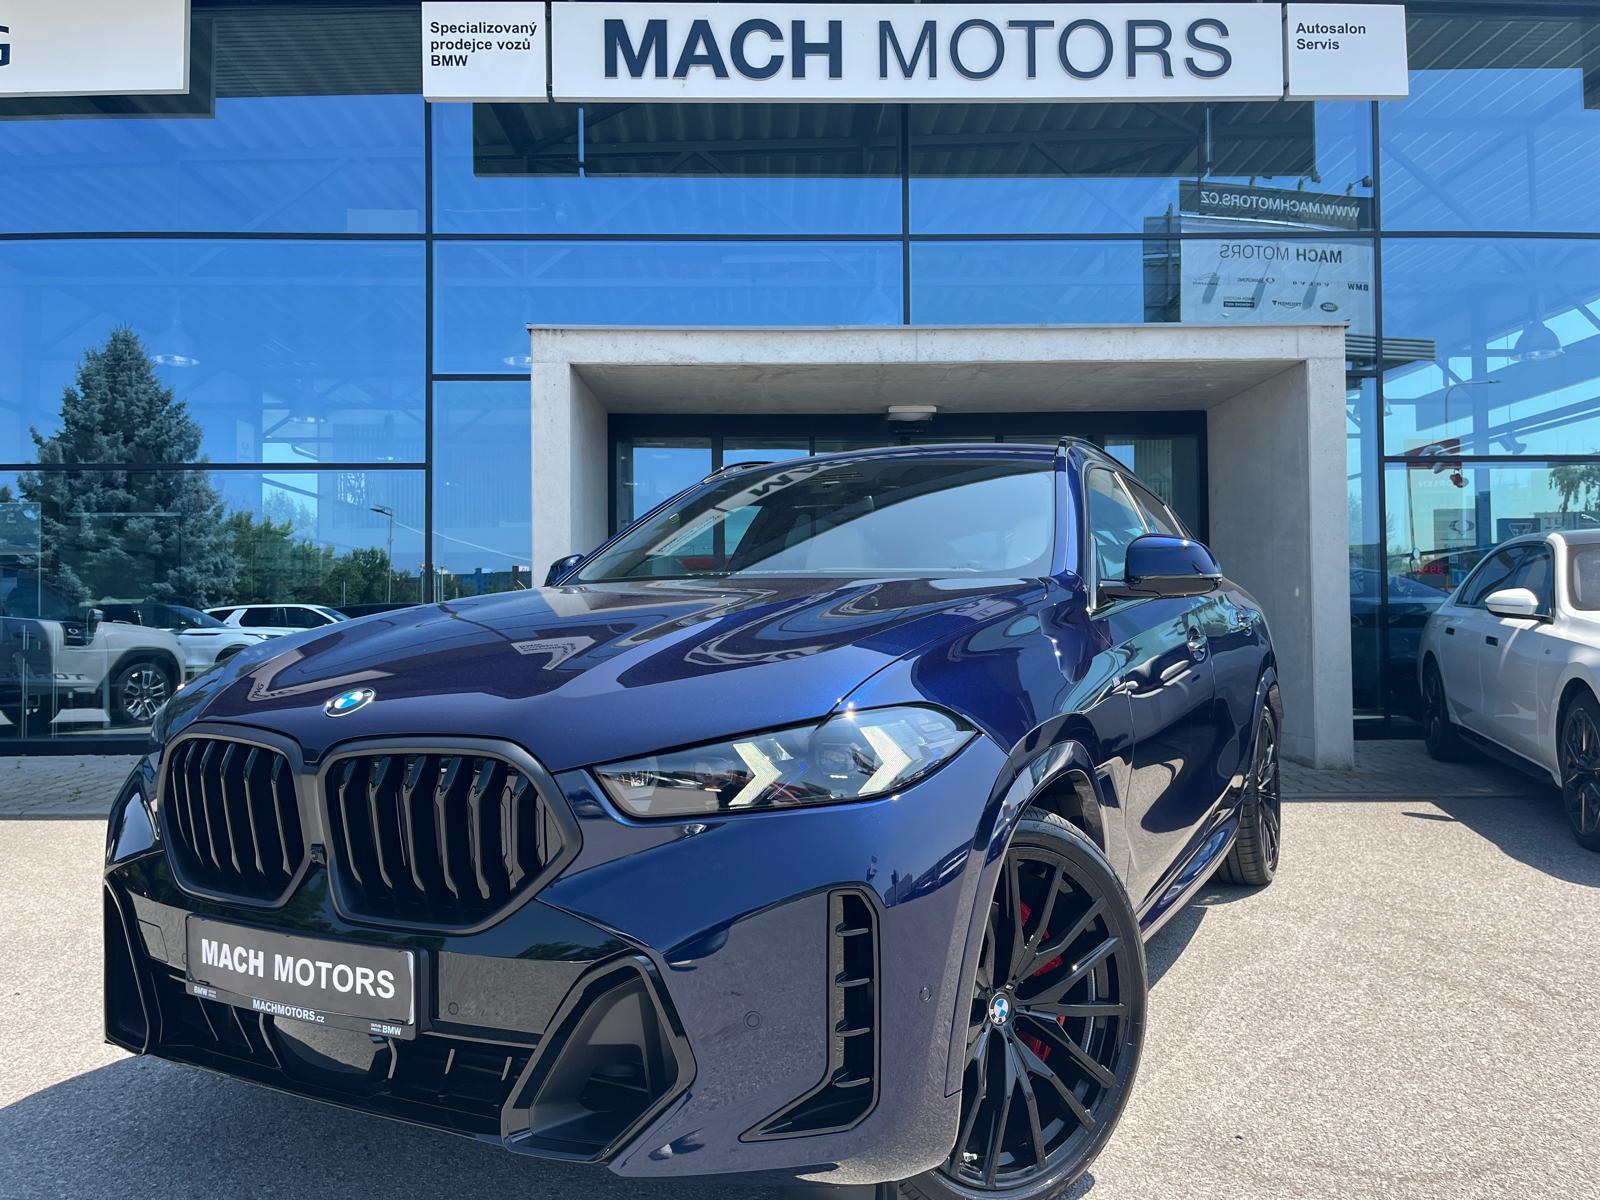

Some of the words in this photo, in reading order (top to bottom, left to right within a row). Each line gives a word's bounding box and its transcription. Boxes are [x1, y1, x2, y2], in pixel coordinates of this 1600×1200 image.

[430, 21, 537, 36] Specializovaný
[1296, 22, 1366, 34] Autosalon
[430, 38, 493, 53] prodejce
[497, 38, 531, 50] vozů
[604, 19, 843, 80] MACH
[878, 18, 1233, 80] MOTORS
[1296, 38, 1340, 50] Servis
[431, 54, 468, 66] BMW
[201, 938, 264, 978] MACH
[274, 954, 396, 999] MOTORS
[252, 999, 325, 1024] MACHMOTORS.cz
[382, 1024, 402, 1036] BMW
